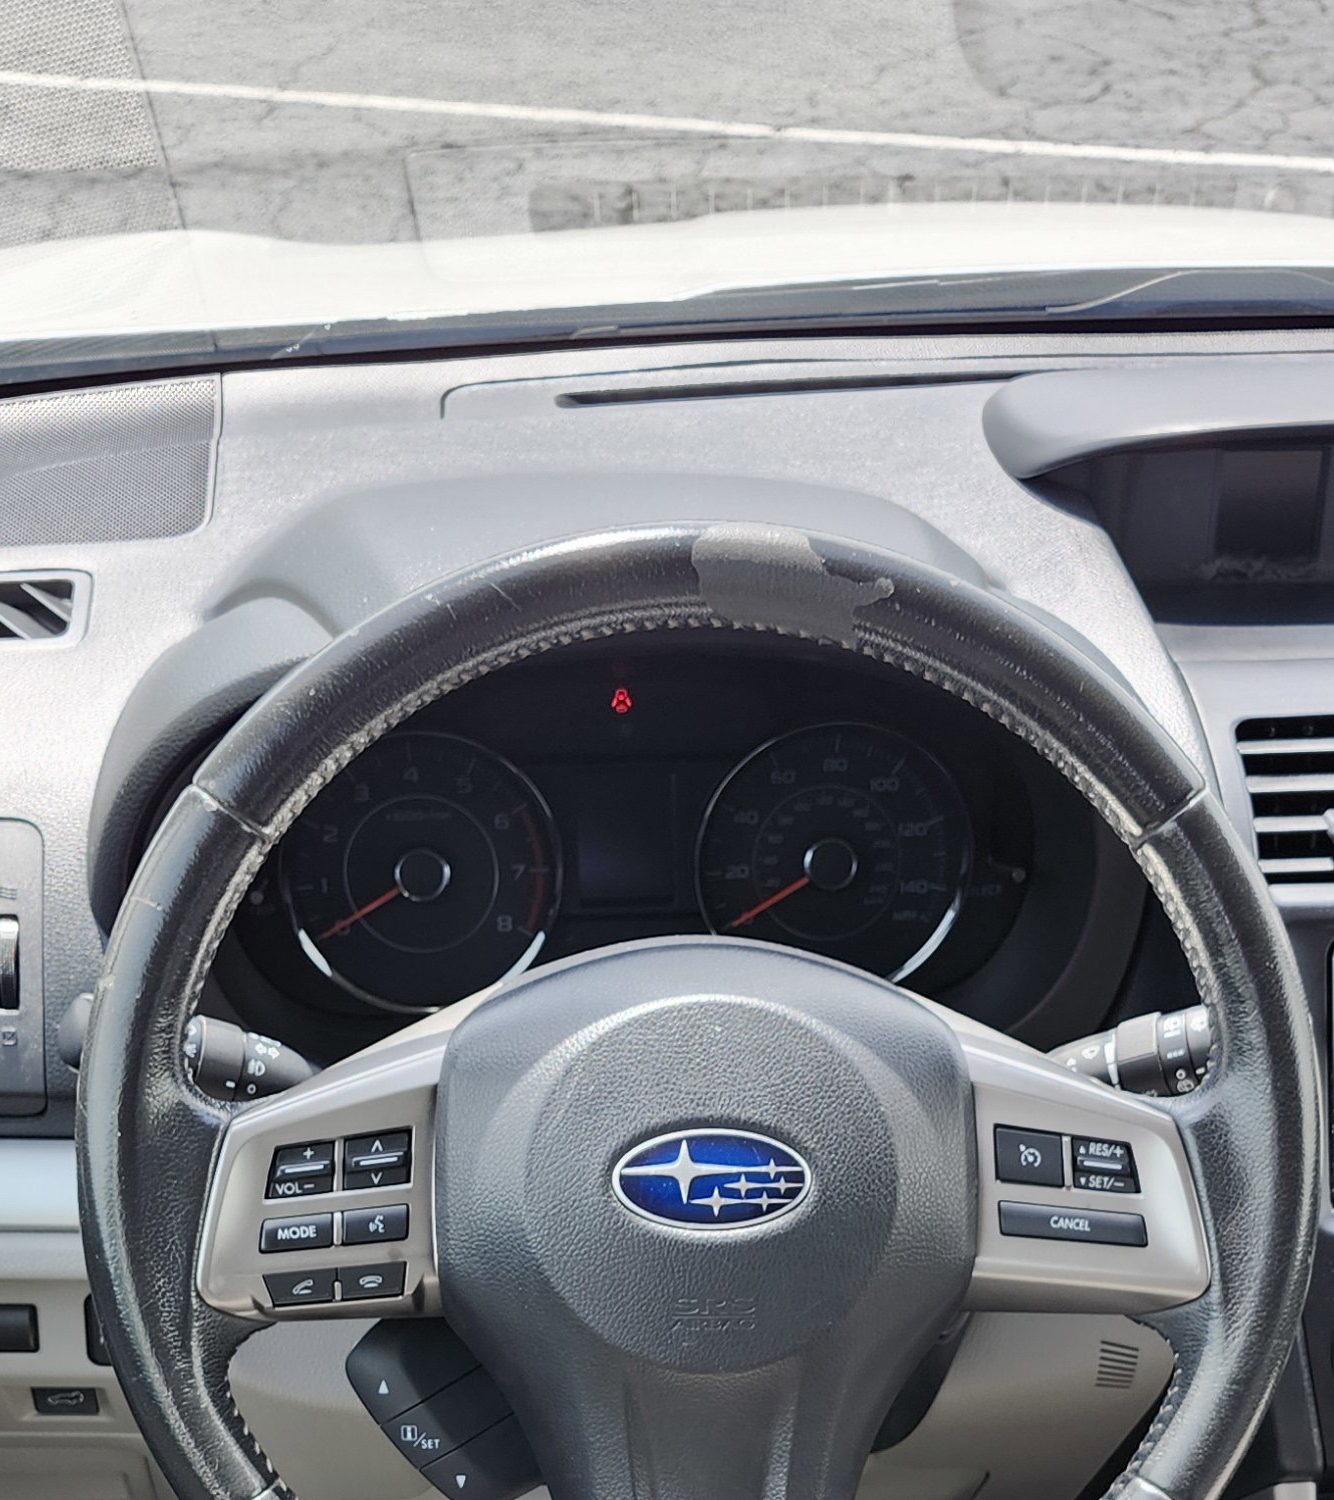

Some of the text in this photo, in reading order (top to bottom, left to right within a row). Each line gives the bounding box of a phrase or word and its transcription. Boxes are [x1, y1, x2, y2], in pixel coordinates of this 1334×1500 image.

[402, 766, 419, 783] 4
[456, 779, 473, 794] 5
[869, 778, 900, 792] 100
[494, 814, 510, 830] 6
[733, 811, 760, 825] 40
[322, 826, 339, 842] 2
[898, 822, 928, 836] 120
[512, 864, 526, 881] 7
[724, 864, 750, 879] 20
[320, 878, 328, 894] 1
[899, 880, 929, 895] 140
[496, 914, 513, 932] 8
[1049, 1215, 1091, 1232] CANCEL
[277, 1225, 317, 1241] MODE
